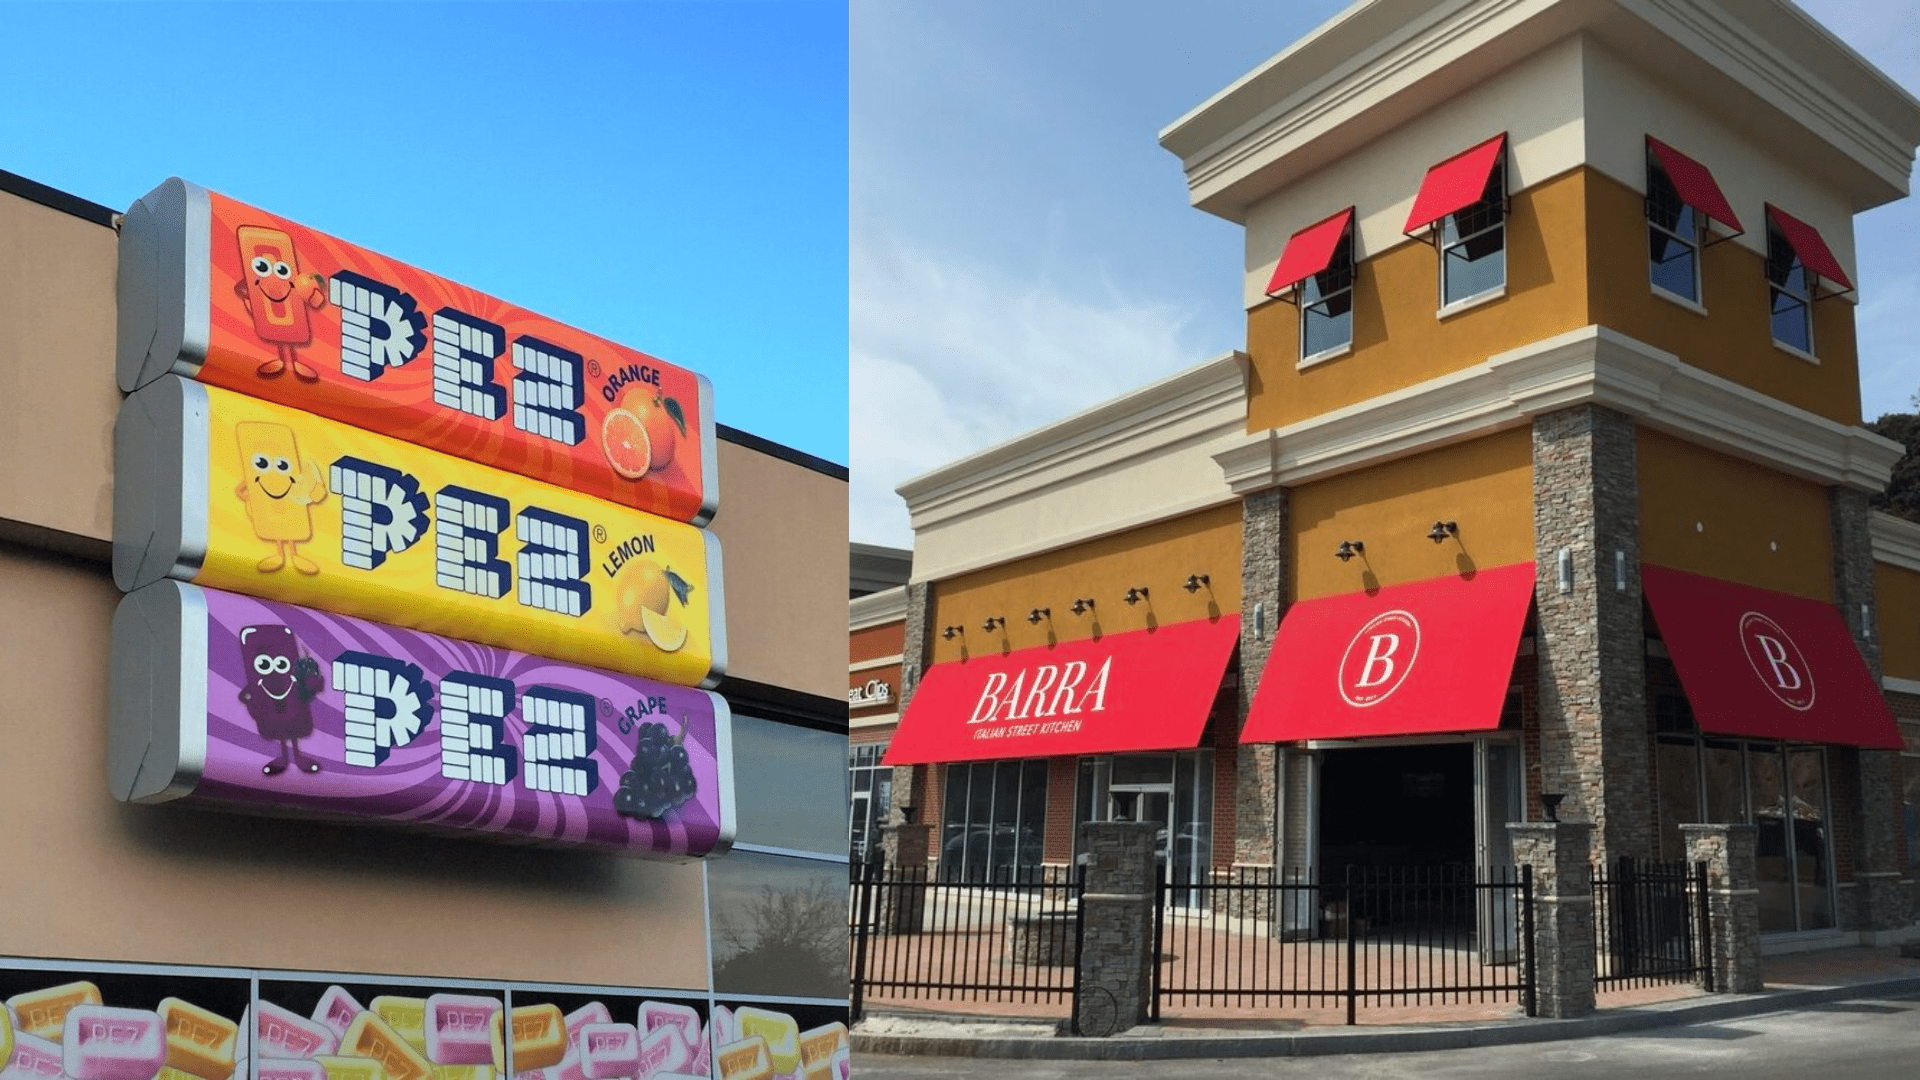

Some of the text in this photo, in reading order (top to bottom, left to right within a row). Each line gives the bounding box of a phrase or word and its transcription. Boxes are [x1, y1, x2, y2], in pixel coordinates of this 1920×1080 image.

[329, 270, 586, 446] PEZ
[602, 364, 660, 402] ORANGE
[329, 455, 591, 617] PEZ
[602, 534, 655, 578] LEMON
[1355, 633, 1399, 687] B
[1754, 634, 1801, 689] B
[618, 696, 667, 735] GRAPE
[967, 655, 1113, 724] BARRA
[332, 650, 600, 796] PEZ
[973, 719, 1082, 740] ITALIAN STREET KITCHEN
